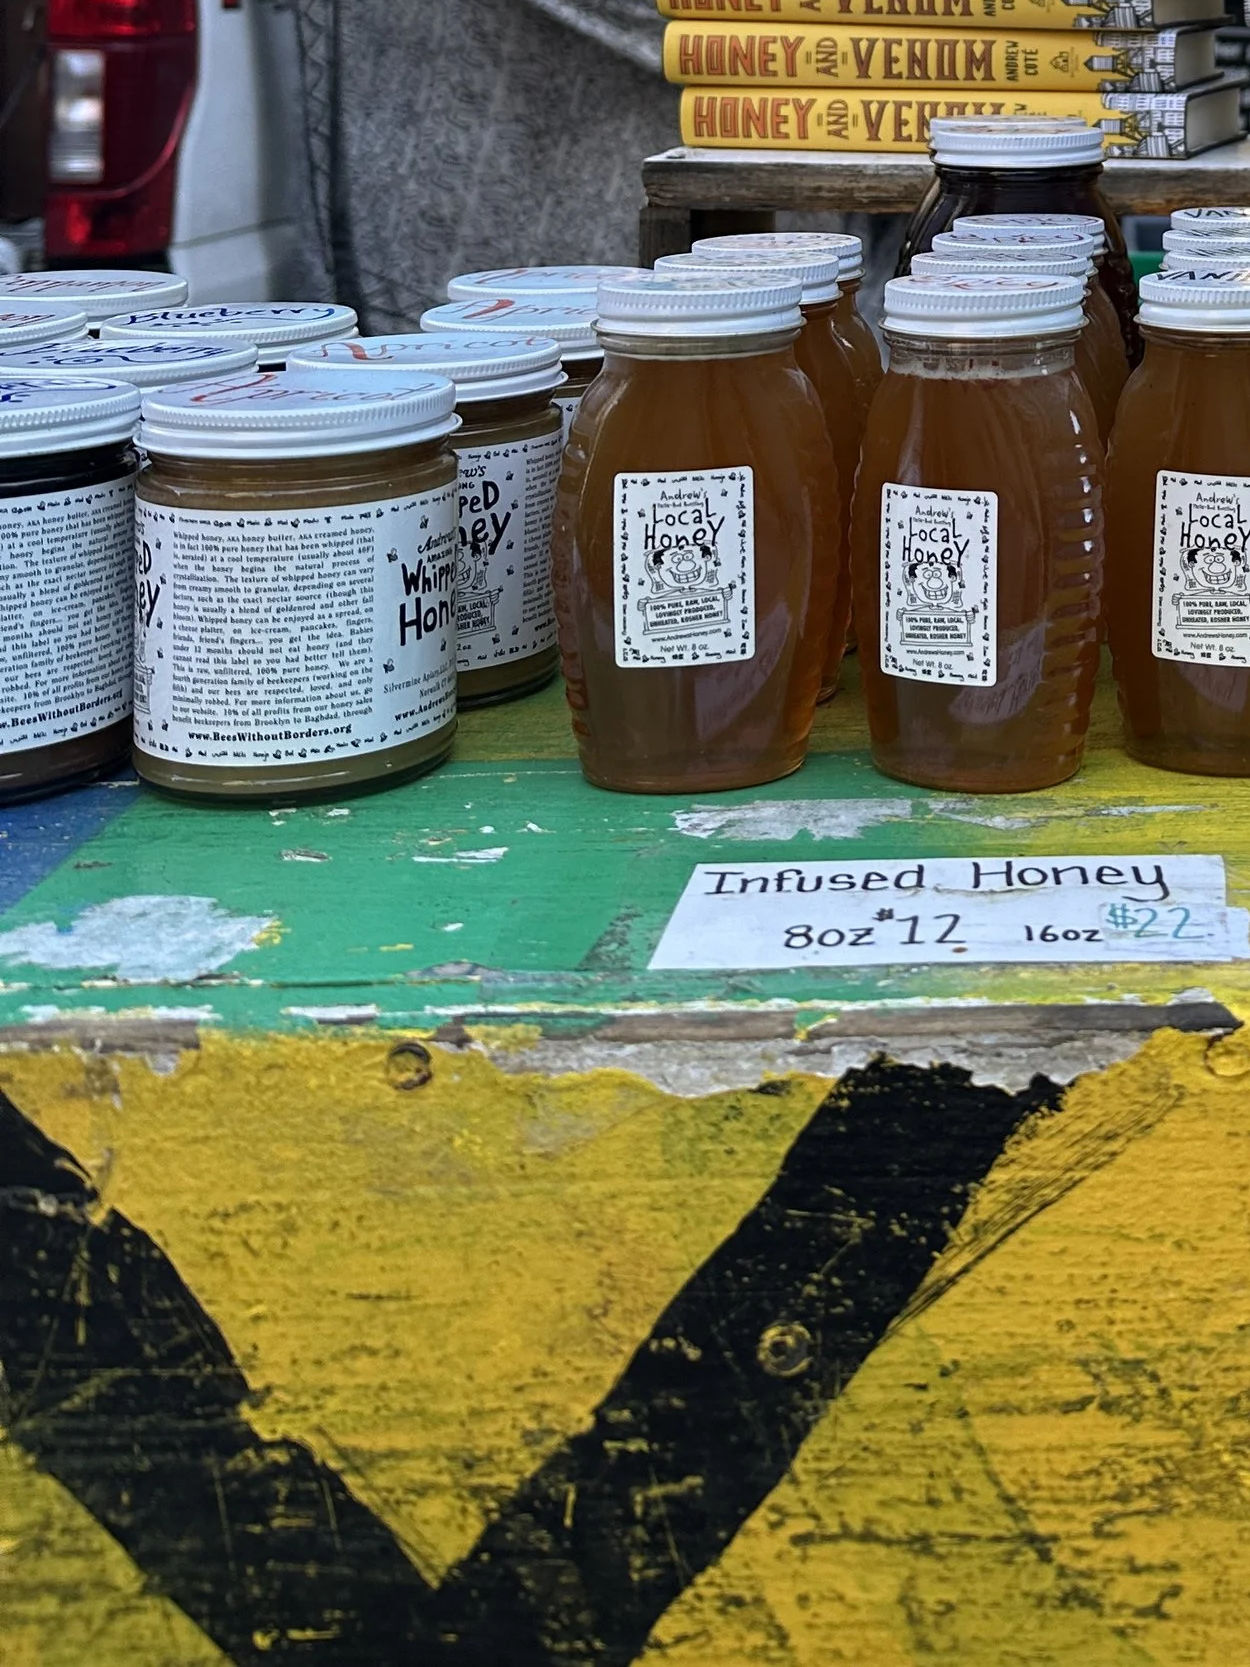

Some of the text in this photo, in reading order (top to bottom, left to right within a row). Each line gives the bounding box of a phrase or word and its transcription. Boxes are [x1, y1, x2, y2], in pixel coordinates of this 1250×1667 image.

[679, 35, 996, 81] HONEY AND VENOM
[1005, 41, 1018, 82] ANDREW
[1022, 50, 1038, 76] COTÉ
[693, 97, 816, 140] HONEY
[827, 100, 849, 140] AND
[126, 306, 336, 327] Blueberry
[311, 336, 549, 361] Apricot
[158, 373, 436, 407] Apricot
[660, 487, 709, 500] Andrew's
[1196, 492, 1239, 505] Andrew's
[915, 505, 954, 518] Andrew's
[241, 535, 265, 543] honey
[315, 529, 347, 539] creamed
[402, 544, 458, 596] Whippe
[188, 723, 352, 742] www.BeesWithoutBorders.org
[704, 861, 1167, 902] Infused Honey
[784, 924, 877, 950] 8oz
[1024, 925, 1101, 943] 16oz
[1107, 903, 1194, 940] $22
